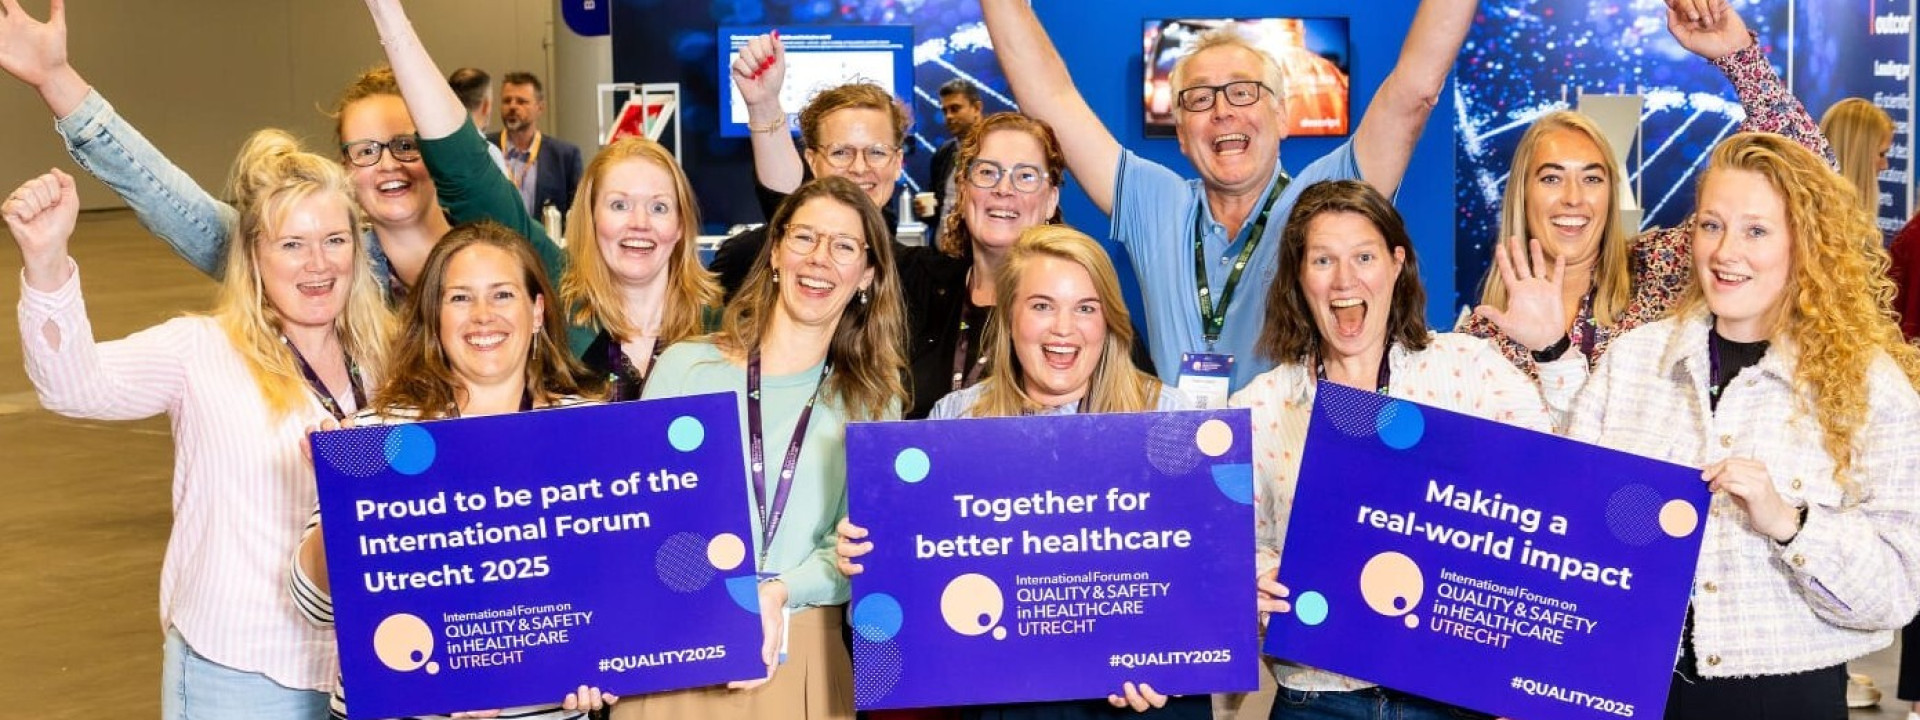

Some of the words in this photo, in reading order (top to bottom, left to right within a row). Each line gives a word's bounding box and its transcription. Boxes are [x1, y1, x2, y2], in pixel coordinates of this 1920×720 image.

[356, 491, 447, 521] Proud
[454, 492, 486, 512] to
[494, 486, 532, 508] be
[541, 478, 603, 509] part
[610, 472, 641, 496] of
[647, 469, 699, 492] the
[953, 490, 1098, 522] Together
[1105, 487, 1150, 512] for
[1426, 480, 1541, 533] Making
[1549, 515, 1568, 535] a
[359, 517, 547, 555] International
[555, 512, 650, 537] Forum
[916, 534, 1013, 559] better
[1022, 526, 1192, 554] healthcare
[1357, 506, 1514, 560] real-world
[1521, 540, 1633, 590] impact
[364, 564, 475, 592] Utrecht
[480, 555, 550, 582] 2025
[1016, 571, 1092, 585] International
[1093, 571, 1132, 582] Forum
[1133, 572, 1149, 580] on
[1016, 586, 1091, 602] QUALITY
[1092, 585, 1105, 599] &
[1107, 582, 1170, 599] SAFETY
[1440, 568, 1519, 597] International
[1519, 588, 1559, 607] Forum
[1560, 601, 1577, 612] on
[443, 605, 516, 622] International
[517, 605, 555, 616] Forum
[556, 603, 571, 611] on
[445, 619, 516, 638] QUALITY
[518, 618, 530, 631] &
[532, 611, 592, 630] SAFETY
[1017, 605, 1031, 619] in
[1034, 600, 1143, 618] HEALTHCARE
[1433, 599, 1448, 615] in
[1450, 604, 1565, 645] HEALTHCARE
[1437, 583, 1514, 613] QUALITY
[1514, 602, 1527, 618] &
[1529, 606, 1597, 634] SAFETY
[447, 641, 461, 654] in
[463, 629, 569, 652] HEALTHCARE
[1018, 619, 1096, 636] UTRECHT
[1431, 617, 1511, 648] UTRECHT
[450, 650, 523, 669] UTRECHT
[599, 645, 726, 672] #QUALITY2025
[1109, 649, 1231, 669] #QUALITY2025
[1511, 676, 1634, 717] #QUALITY2025
